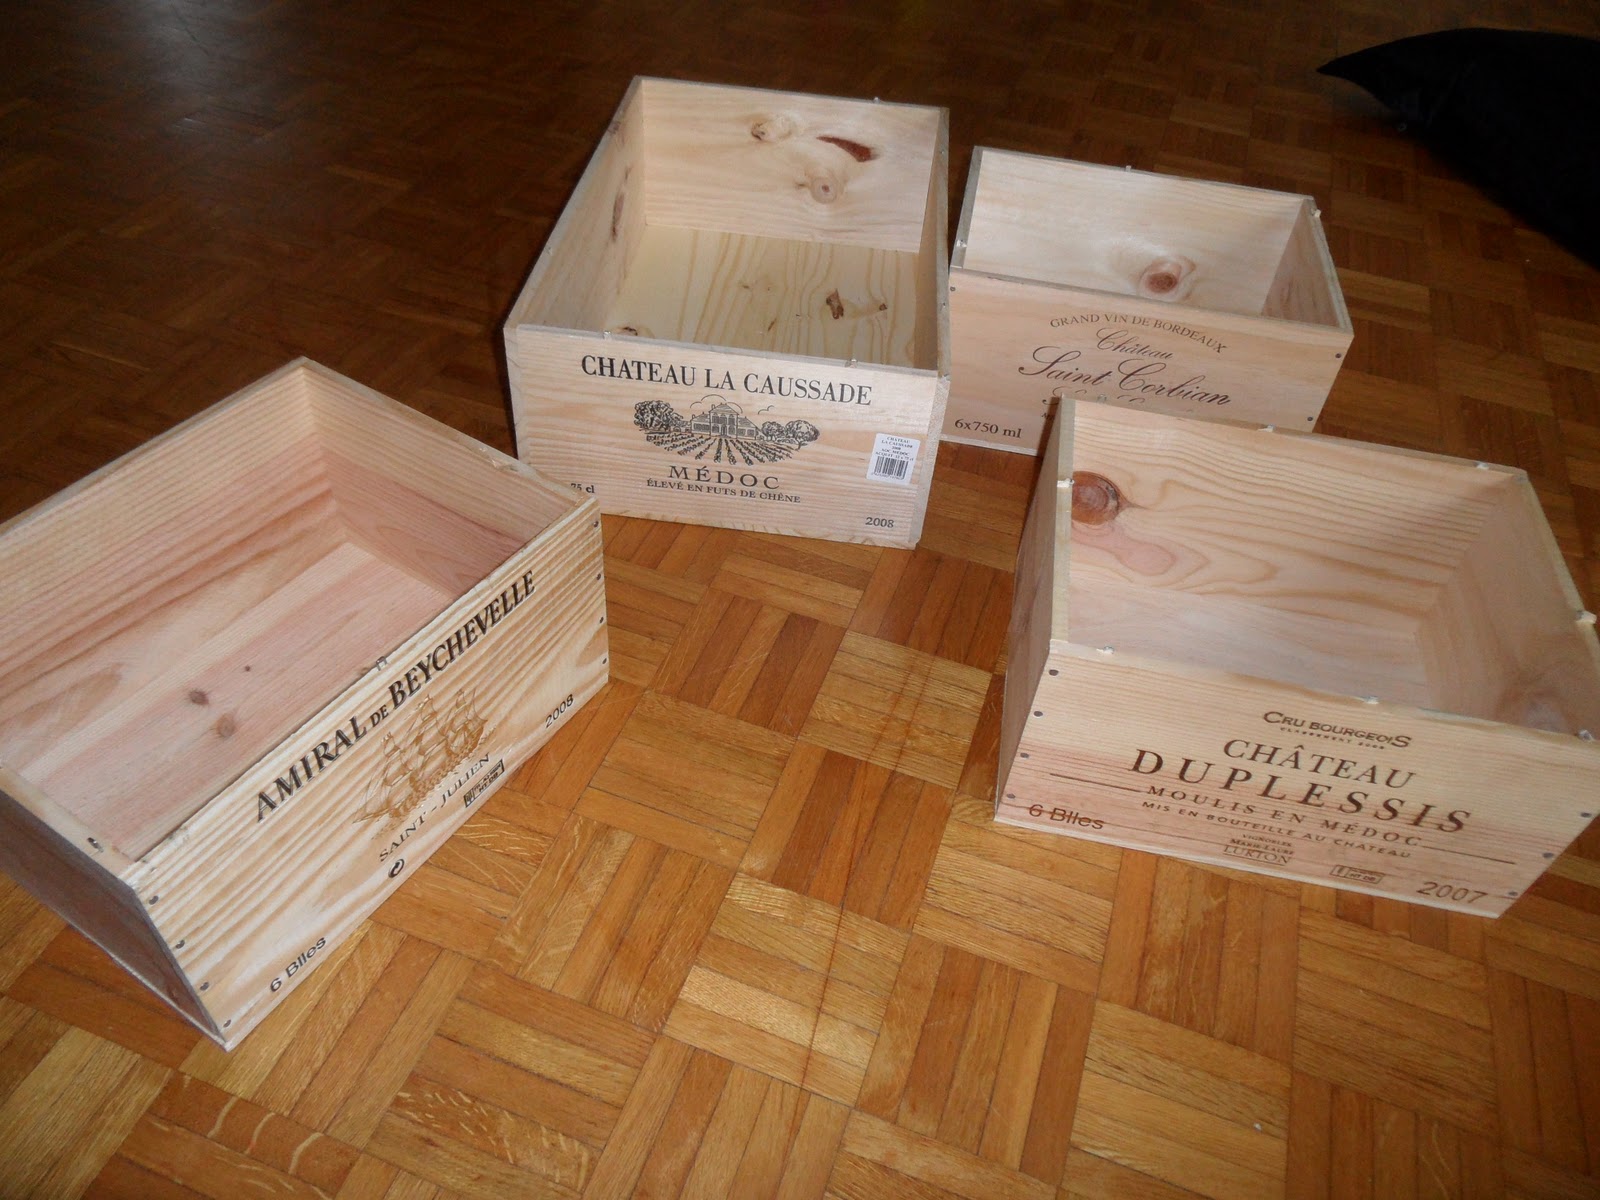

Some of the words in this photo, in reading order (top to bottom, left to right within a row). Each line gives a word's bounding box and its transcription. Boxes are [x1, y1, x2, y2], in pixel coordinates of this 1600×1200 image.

[1050, 314, 1100, 328] GRAND
[1104, 313, 1128, 324] VIN
[1132, 316, 1150, 326] DE
[1153, 319, 1227, 353] BORDEAUX
[1096, 327, 1173, 360] Château
[581, 355, 696, 387] CHATEAU
[704, 368, 736, 390] LA
[744, 373, 872, 406] CAUSSADE
[1018, 345, 1113, 386] Saint
[1118, 358, 1231, 406] Corbian
[954, 418, 999, 435] 6x750
[1003, 427, 1022, 439] ml
[586, 485, 595, 494] cl
[647, 478, 684, 491] ÉLEVÉ
[687, 483, 703, 493] EN
[707, 486, 737, 496] FUTS
[740, 489, 756, 498] DE
[759, 491, 800, 504] CHÊNE
[668, 465, 780, 490] MÉDOC
[865, 516, 895, 529] 2008
[258, 716, 367, 822] AMIRAL
[369, 704, 389, 728] DE
[388, 570, 535, 709] BEYCHEVELLE
[546, 693, 573, 728] 2008
[441, 752, 489, 808] JULIEN
[1223, 739, 1417, 790] CHÂTEAU
[1130, 749, 1472, 834] DUPLESSIS
[1029, 804, 1043, 817] 6
[1050, 807, 1105, 830] Blles
[1142, 801, 1170, 812] MIS
[1179, 807, 1198, 818] EN
[1206, 814, 1296, 837] BOUTEILLE
[1302, 832, 1326, 842] AU
[1334, 838, 1411, 858] CHATEAU
[1146, 786, 1256, 816] MOULIS
[1271, 810, 1305, 824] EN
[1321, 819, 1422, 847] MÉDOC
[1224, 845, 1292, 864] LURTON
[1242, 833, 1292, 847] VIGNOBLES
[1416, 881, 1488, 904] 2007
[270, 977, 282, 992] 6
[285, 937, 326, 977] Blles
